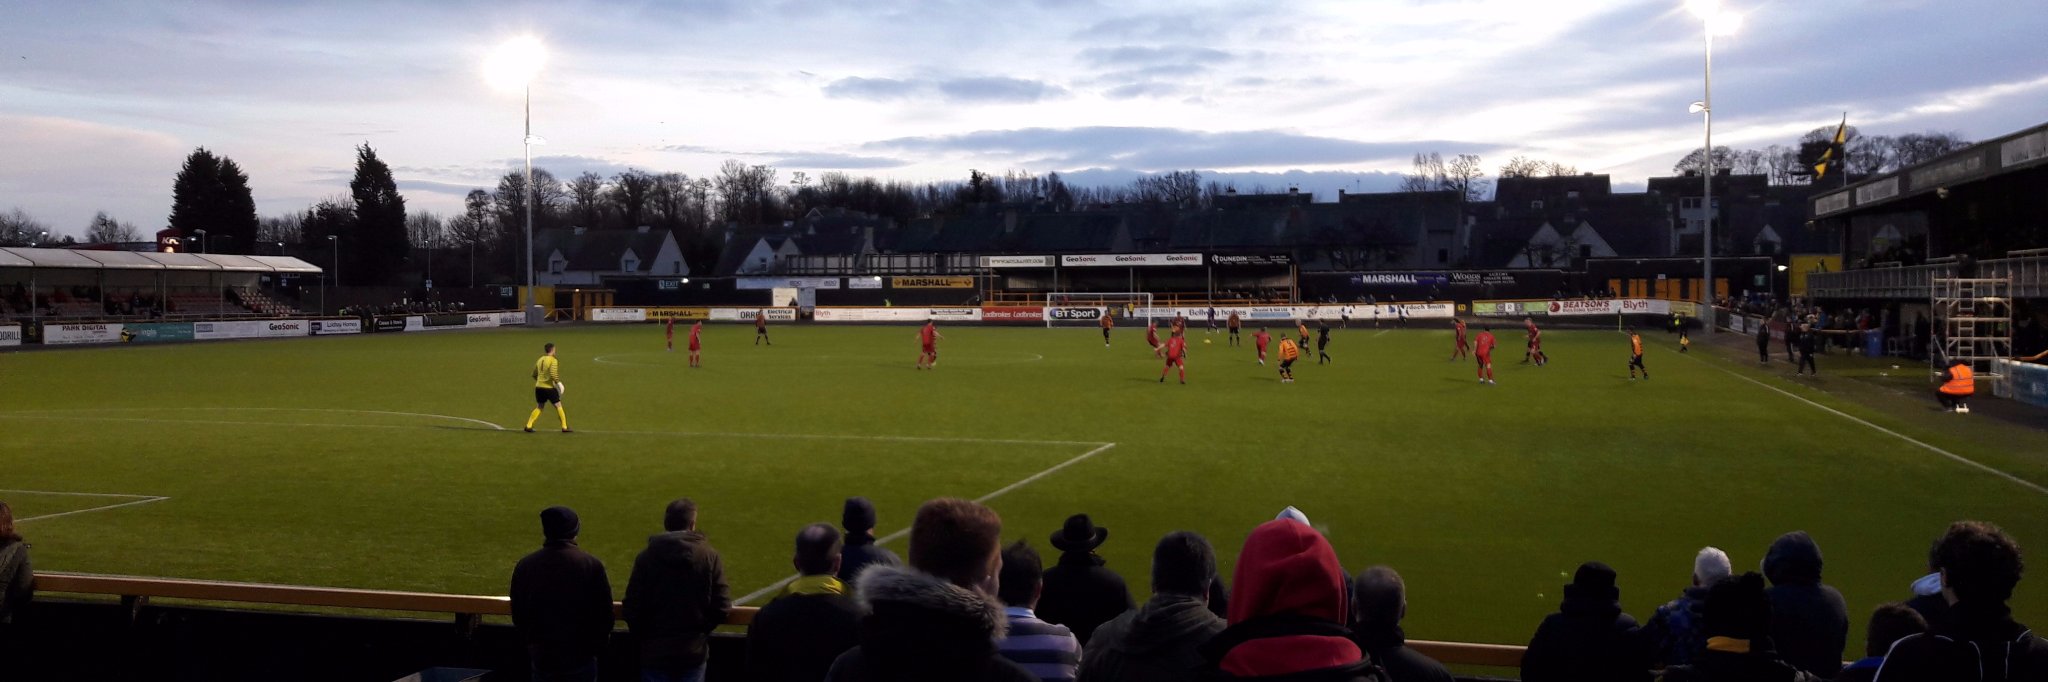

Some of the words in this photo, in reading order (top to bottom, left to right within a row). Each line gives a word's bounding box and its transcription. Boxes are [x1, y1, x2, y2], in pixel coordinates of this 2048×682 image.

[902, 278, 951, 286] MARSHALL
[1362, 274, 1417, 283] MARSHALL
[1623, 300, 1648, 309] Blyth
[1070, 310, 1096, 318] Sport
[269, 323, 299, 331] GeoSonic
